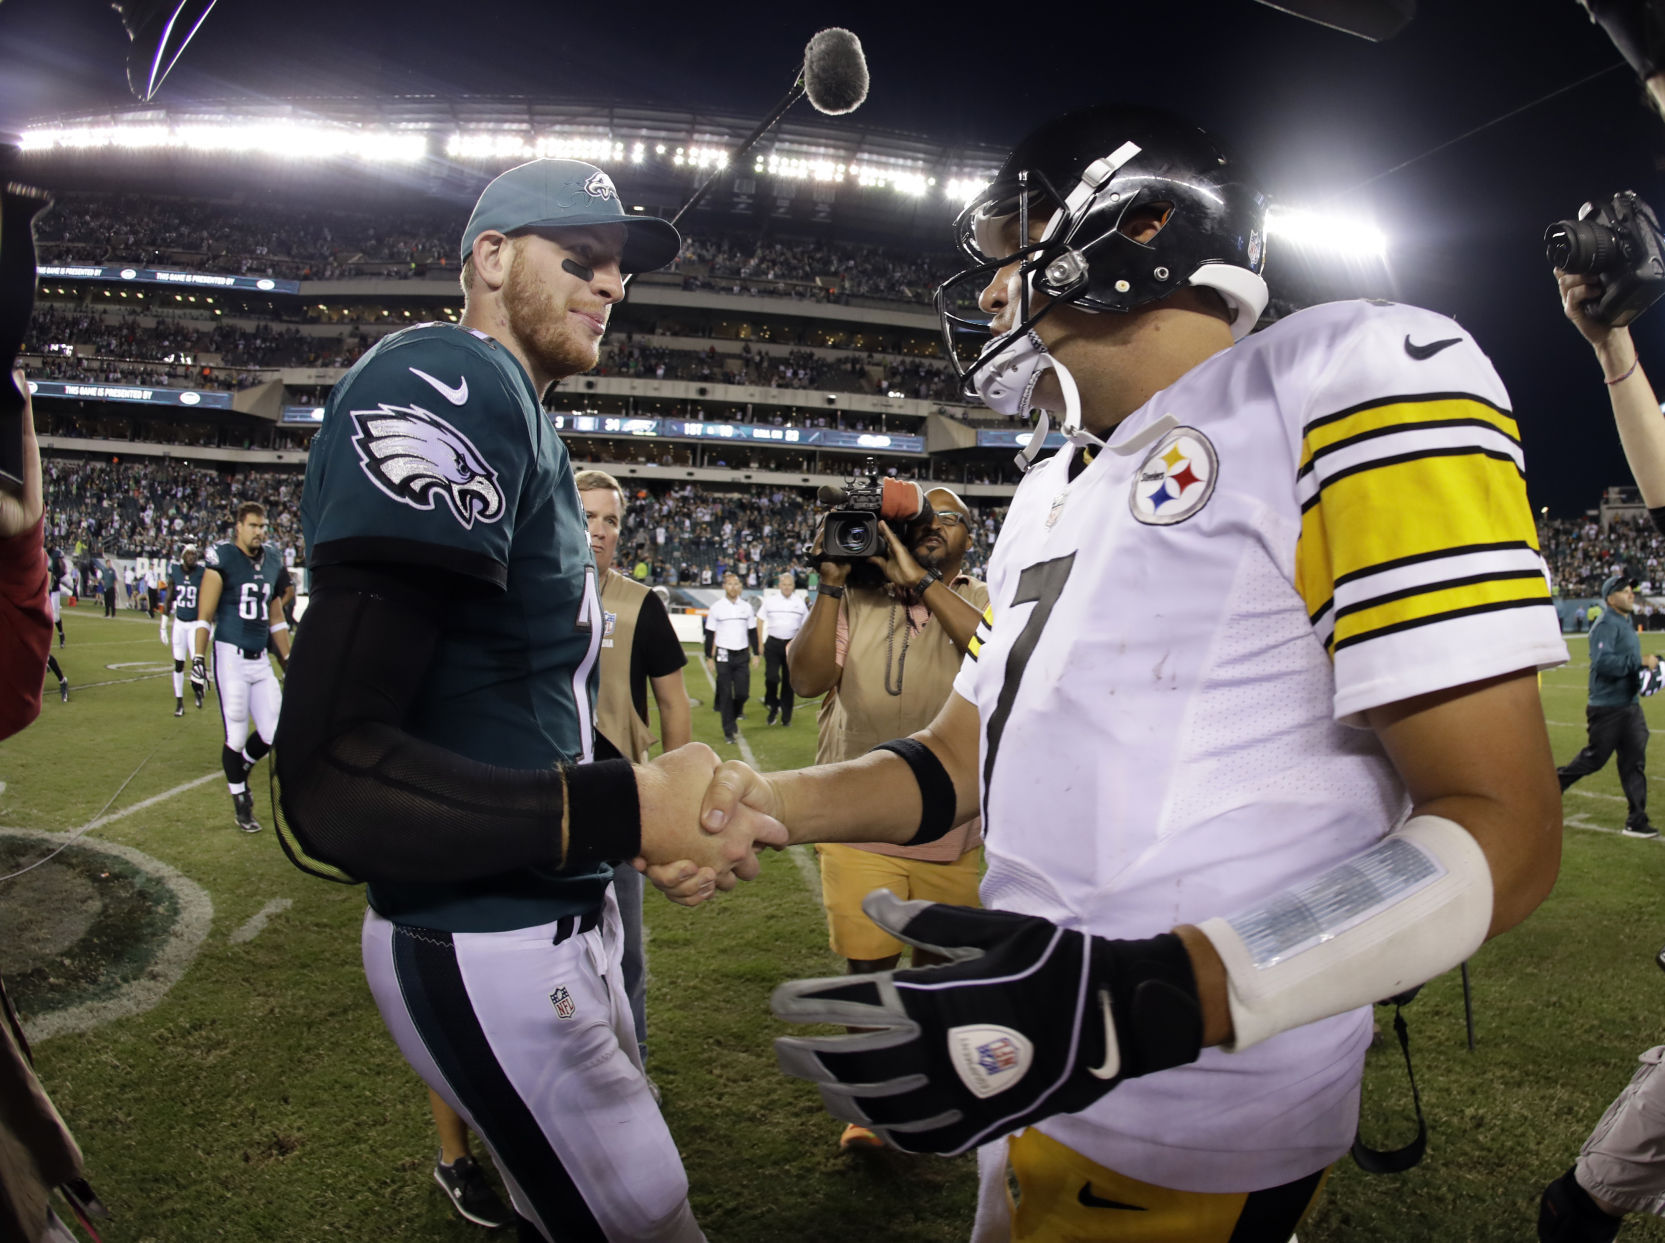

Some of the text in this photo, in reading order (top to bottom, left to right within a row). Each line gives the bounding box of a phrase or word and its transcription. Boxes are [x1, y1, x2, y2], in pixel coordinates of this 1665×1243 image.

[47, 267, 60, 275] GAME
[66, 268, 95, 276] PRESENTED
[156, 272, 169, 281] THIS
[169, 273, 186, 282] GAME
[192, 275, 226, 285] PRESENTED
[225, 277, 235, 286] BY
[65, 385, 153, 400] THIS GAME IS PRESENTED BY
[176, 584, 198, 609] 29
[238, 582, 271, 621] 61
[983, 549, 1078, 841] 7
[556, 998, 574, 1016] NFL
